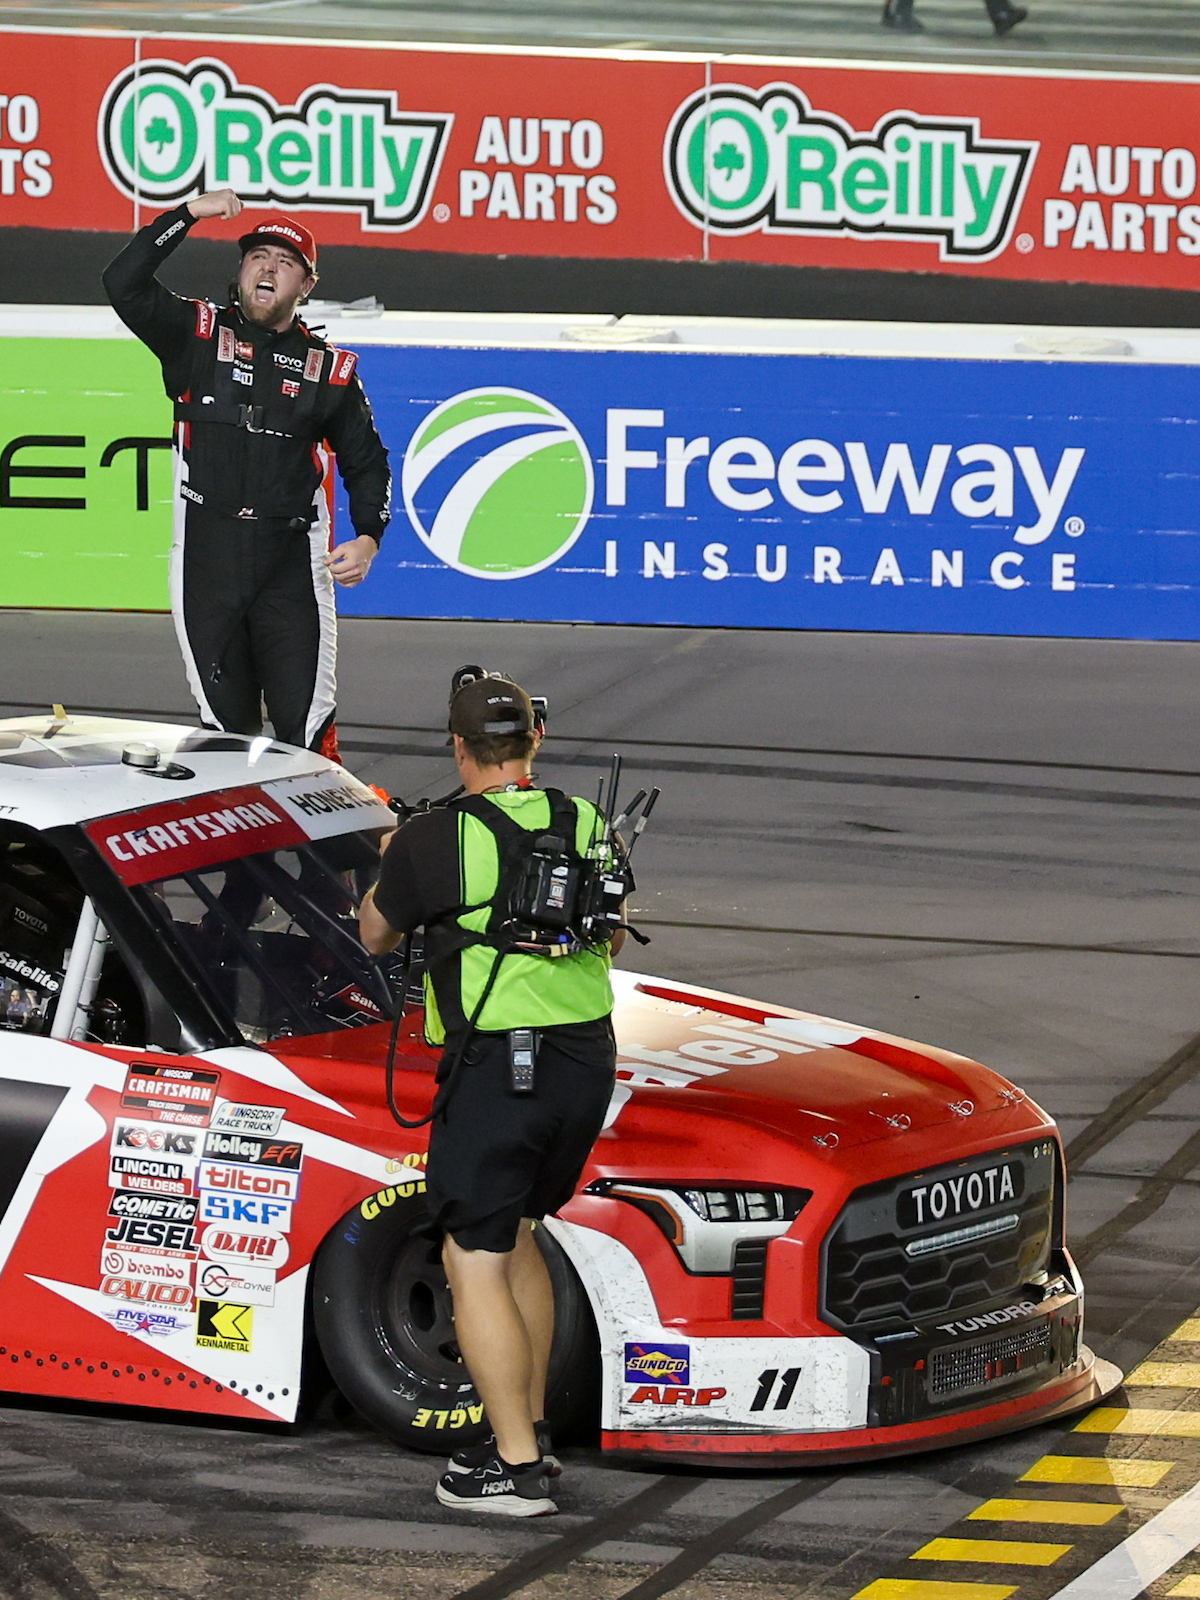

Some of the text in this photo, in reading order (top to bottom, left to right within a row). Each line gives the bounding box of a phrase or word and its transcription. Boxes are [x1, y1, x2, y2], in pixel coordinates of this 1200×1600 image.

[119, 82, 425, 208] O'Reilly
[474, 115, 604, 170] AUTO
[687, 107, 1008, 237] O'Reilly
[1059, 143, 1198, 200] AUTO
[459, 169, 618, 225] PARTS
[1043, 198, 1200, 256] PARTS
[273, 352, 305, 369] TOYO
[604, 407, 1086, 546] Freeway
[604, 540, 1077, 591] INSURANCE
[105, 802, 283, 862] CRAFTSMAN
[14, 907, 48, 933] TOYOTA
[163, 1069, 194, 1080] NASCAR
[128, 1078, 212, 1101] CRAFTSMAN
[159, 1111, 204, 1125] THE CHASE
[216, 1117, 273, 1132] RACE TRUCK
[237, 1108, 275, 1120] NASCAR
[206, 1133, 300, 1164] Holley EFI
[114, 1158, 181, 1179] LINCOLN
[205, 1167, 291, 1196] tilton
[127, 1176, 186, 1194] WELDERS
[911, 1165, 1016, 1223] TOYOTA
[112, 1195, 196, 1220] COMETIC
[205, 1196, 287, 1224] SKF
[107, 1219, 198, 1252] JESEL
[128, 1258, 184, 1279] brembo
[103, 1277, 191, 1306] CALICO
[116, 1309, 178, 1328] FIVE STAR
[936, 1300, 1038, 1337] TUNDRA
[196, 1337, 250, 1353] KENNAMETAL
[628, 1357, 687, 1372] SUNOCO
[628, 1385, 727, 1406] ARP
[749, 1367, 802, 1412] 11
[411, 1402, 484, 1429] AGLE
[481, 1479, 515, 1495] HOKA
